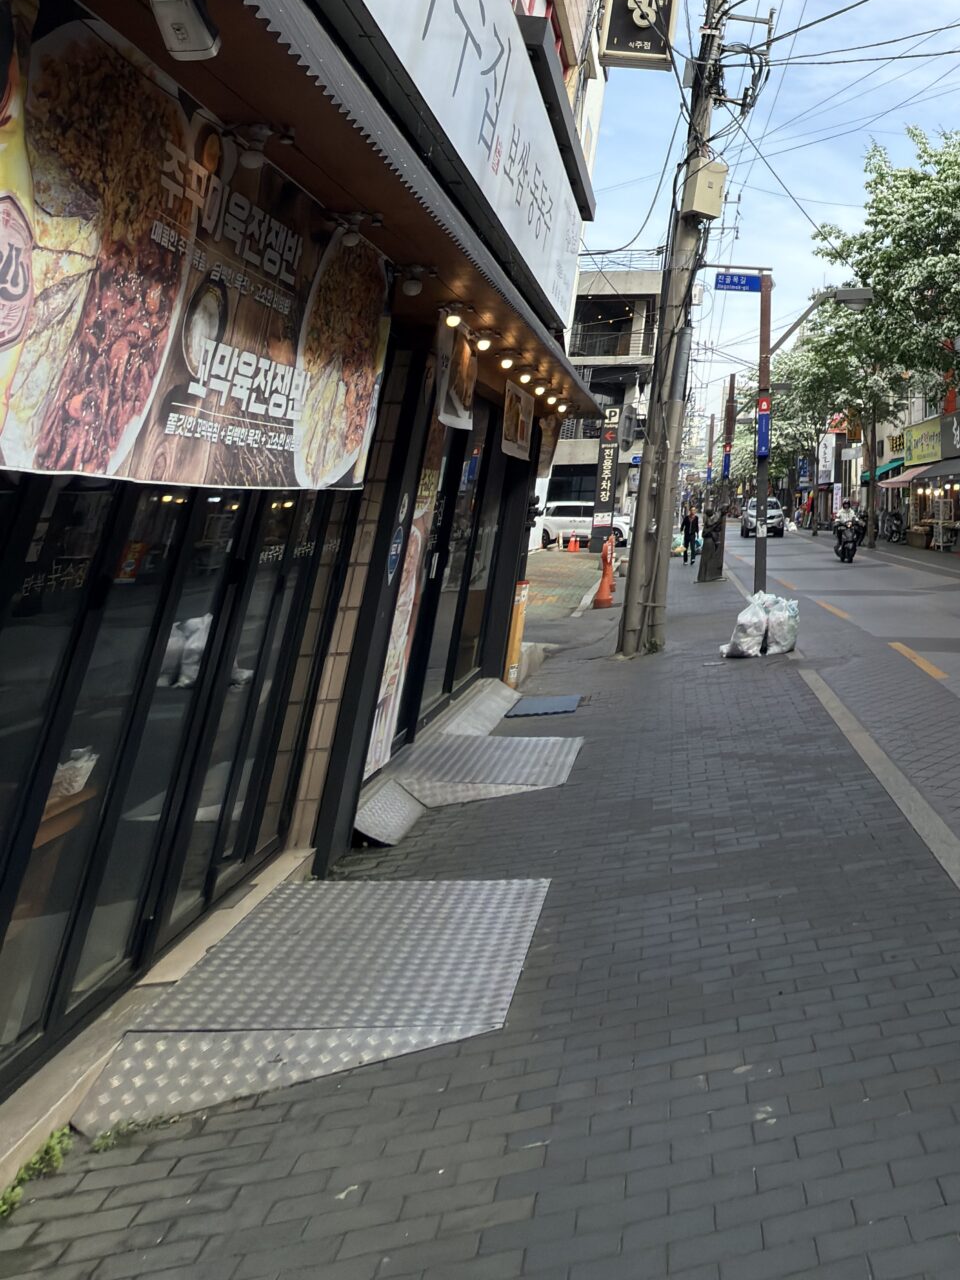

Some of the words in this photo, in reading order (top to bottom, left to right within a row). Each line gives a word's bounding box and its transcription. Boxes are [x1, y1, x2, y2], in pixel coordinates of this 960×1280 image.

[718, 275, 747, 284] 진골목길
[608, 410, 617, 420] P
[600, 448, 614, 502] 전용주차장
